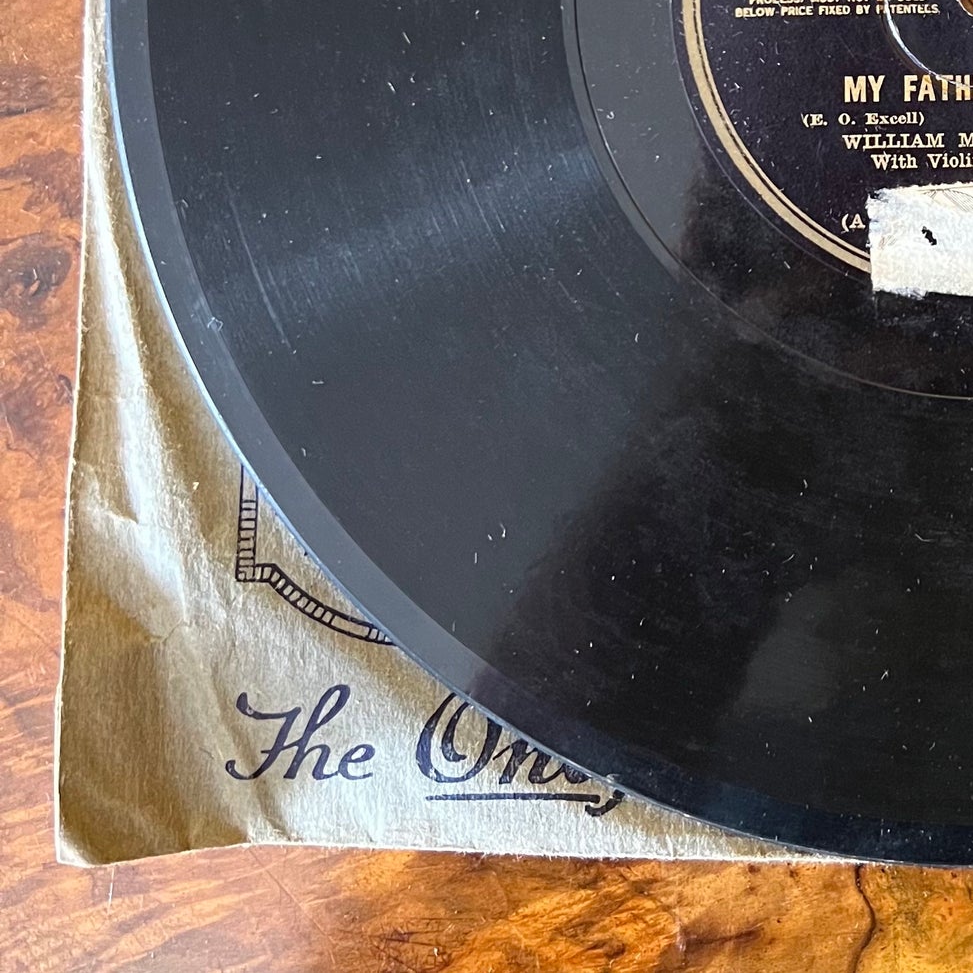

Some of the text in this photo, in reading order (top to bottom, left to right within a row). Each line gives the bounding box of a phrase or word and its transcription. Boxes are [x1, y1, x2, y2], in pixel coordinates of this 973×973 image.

[735, 6, 775, 17] BELOW
[780, 6, 814, 16] PRICE
[818, 5, 851, 15] FIXED
[856, 5, 871, 15] BY
[844, 75, 885, 103] MY
[802, 111, 925, 127] (E. O. Excell)
[842, 133, 945, 149] WILLIAM
[871, 154, 917, 169] With
[224, 684, 376, 781] The
